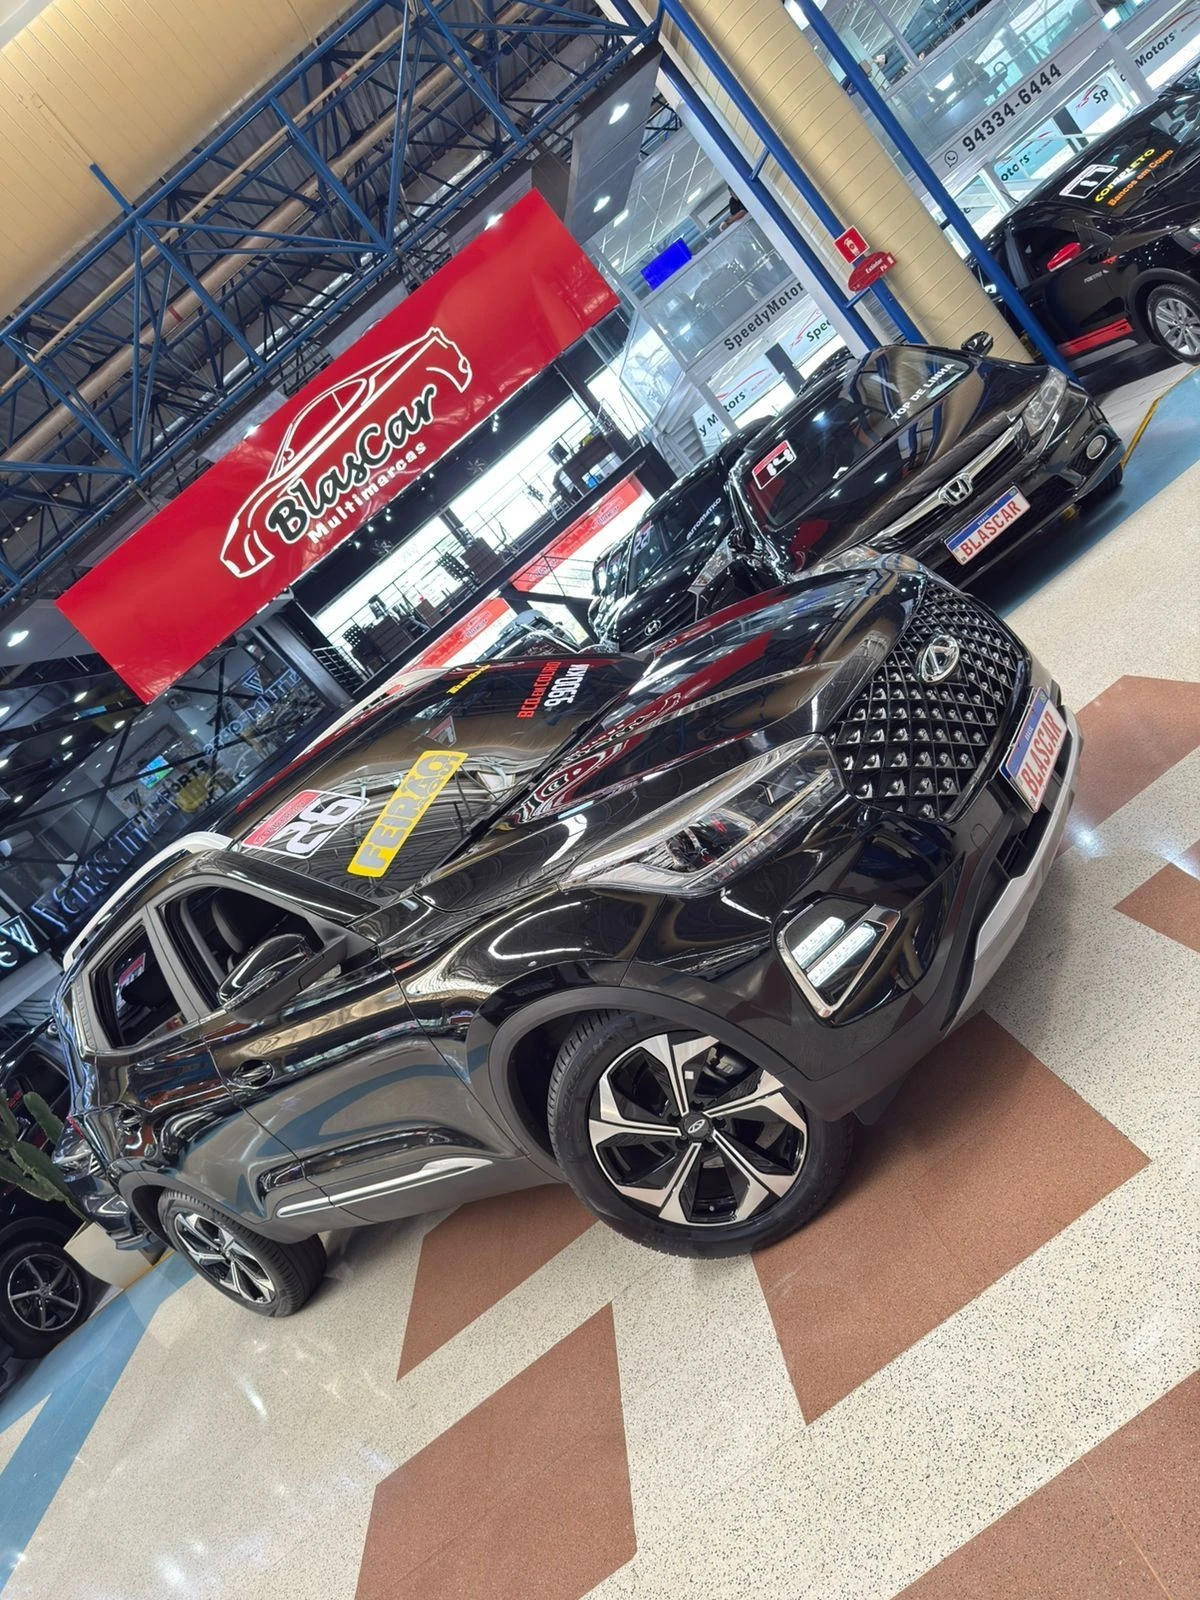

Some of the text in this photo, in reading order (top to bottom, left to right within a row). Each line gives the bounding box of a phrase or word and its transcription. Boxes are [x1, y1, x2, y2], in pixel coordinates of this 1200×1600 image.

[1134, 31, 1176, 69] Motors
[962, 63, 1062, 152] 94334-6444
[1095, 148, 1155, 202] COMPLETO
[724, 282, 804, 351] SpeedyMotor
[891, 363, 956, 420] TOP DE LINHA
[265, 384, 437, 544] BlasCar
[766, 449, 793, 476] 14
[306, 441, 427, 544] Multimarcas
[960, 500, 1022, 556] BLASCAR
[1021, 710, 1062, 797] BLASCAR
[268, 797, 366, 854] 26
